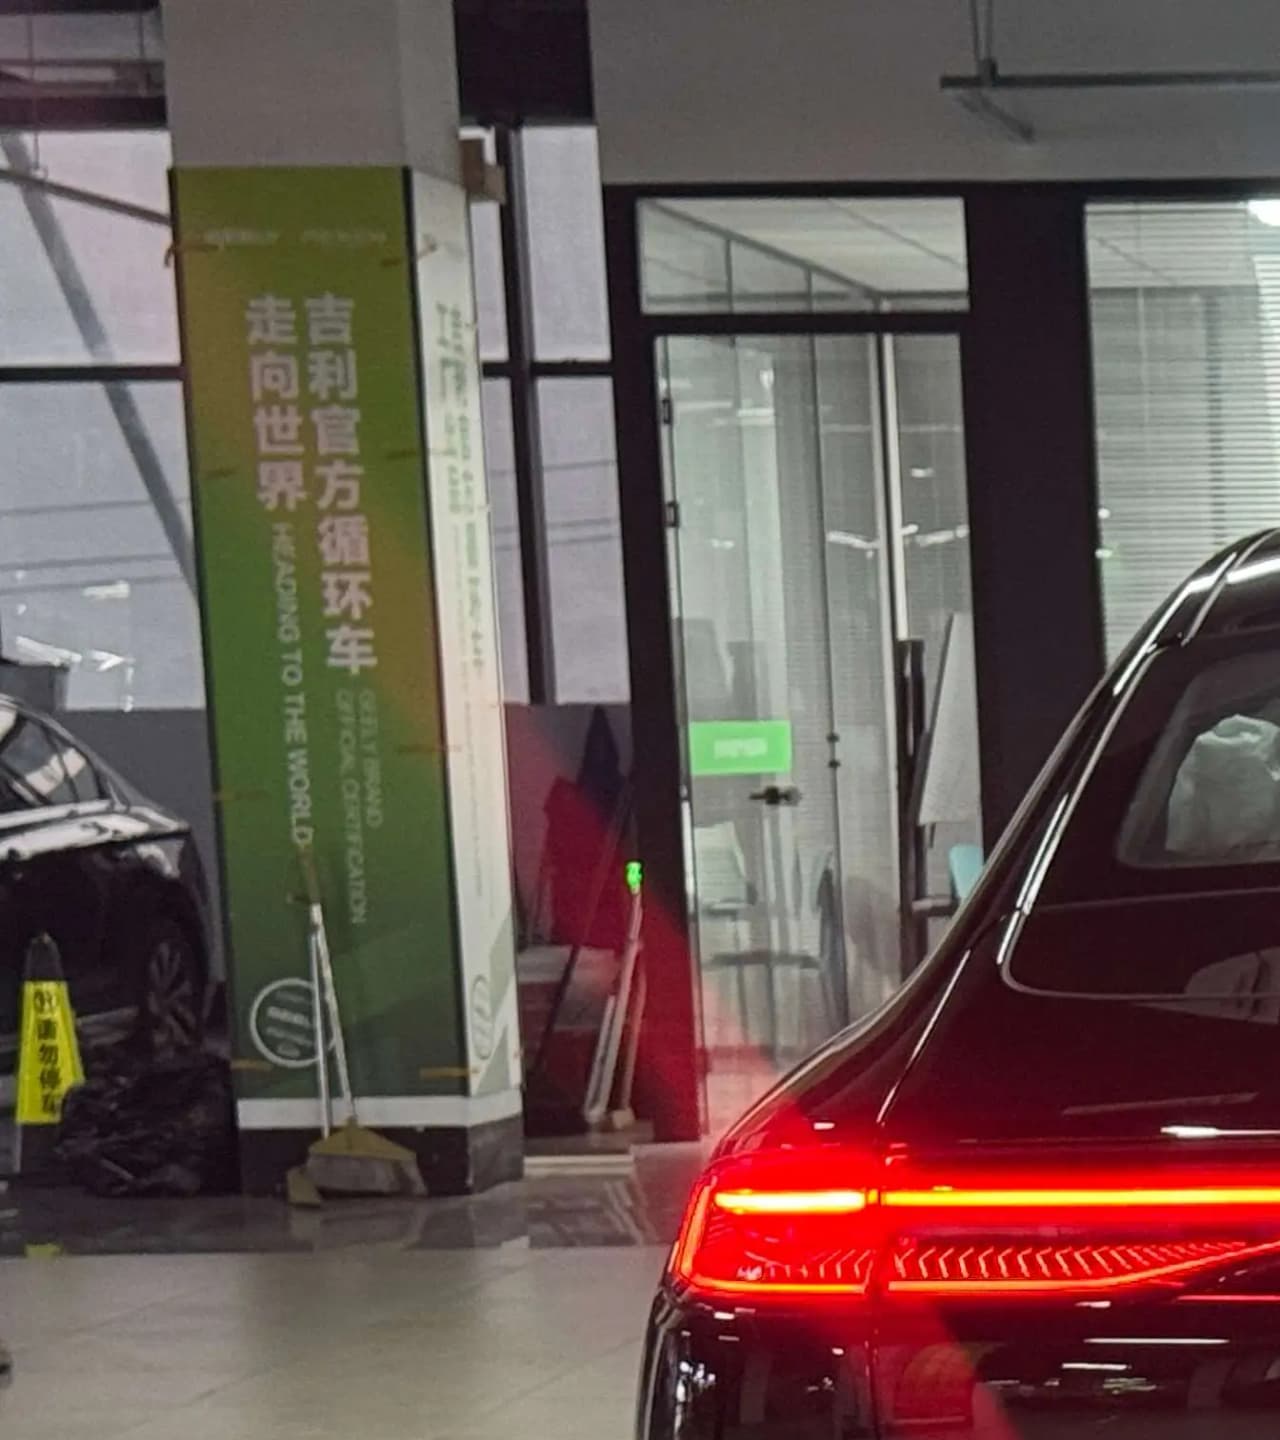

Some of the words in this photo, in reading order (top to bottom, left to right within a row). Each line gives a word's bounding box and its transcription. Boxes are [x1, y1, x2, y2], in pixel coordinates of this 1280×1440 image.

[245, 293, 306, 512] 走向世界
[304, 291, 378, 675] 吉利官方循环车
[272, 522, 300, 642] HEADING
[281, 648, 303, 687] TO
[284, 692, 308, 744] THE
[287, 748, 314, 849] WORLD
